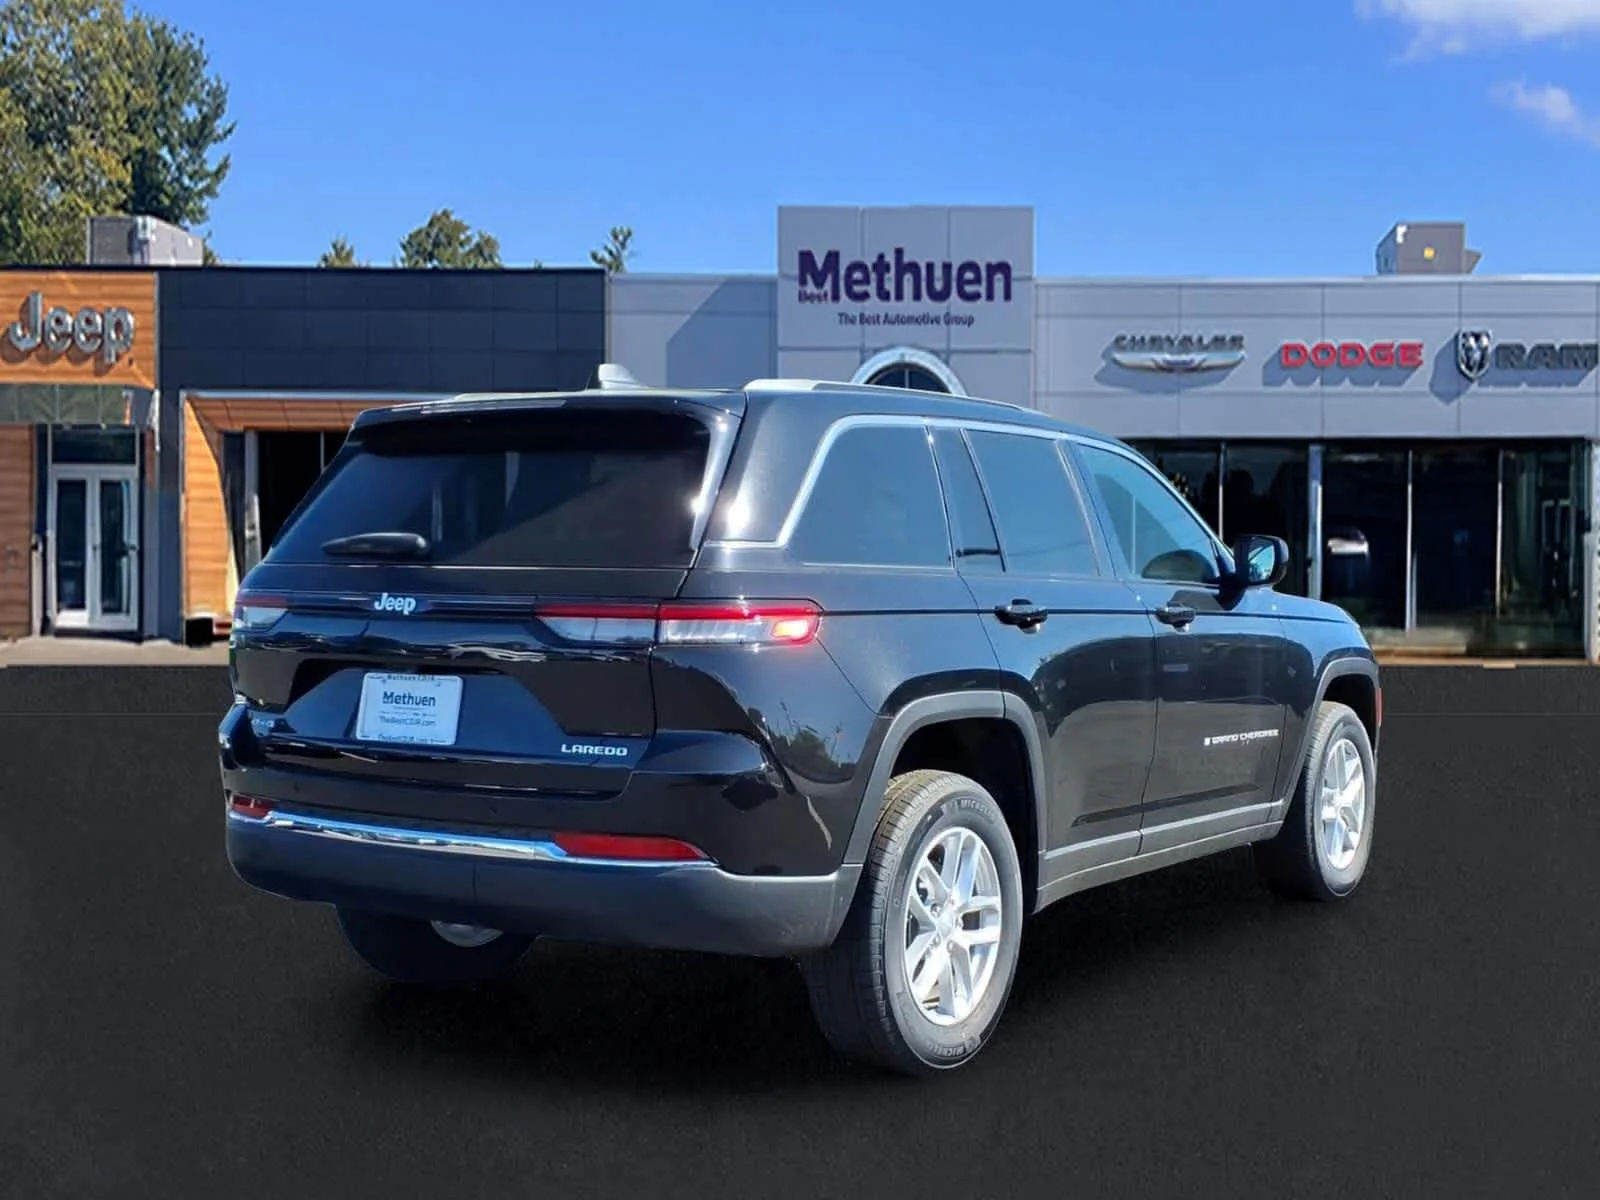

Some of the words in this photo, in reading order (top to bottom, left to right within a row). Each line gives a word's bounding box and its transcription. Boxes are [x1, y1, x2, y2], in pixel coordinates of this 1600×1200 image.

[798, 248, 1012, 303] Methuen
[9, 290, 135, 364] Jeep
[837, 312, 857, 326] The
[859, 312, 881, 326] Best
[882, 312, 941, 326] Automotive
[943, 312, 975, 328] Group
[1113, 334, 1245, 353] CHRYSLER
[1281, 341, 1425, 368] DODGE
[1495, 343, 1599, 370] RAM
[374, 592, 417, 615] Jeep
[382, 690, 436, 707] Methuen
[561, 744, 628, 756] LAREDO
